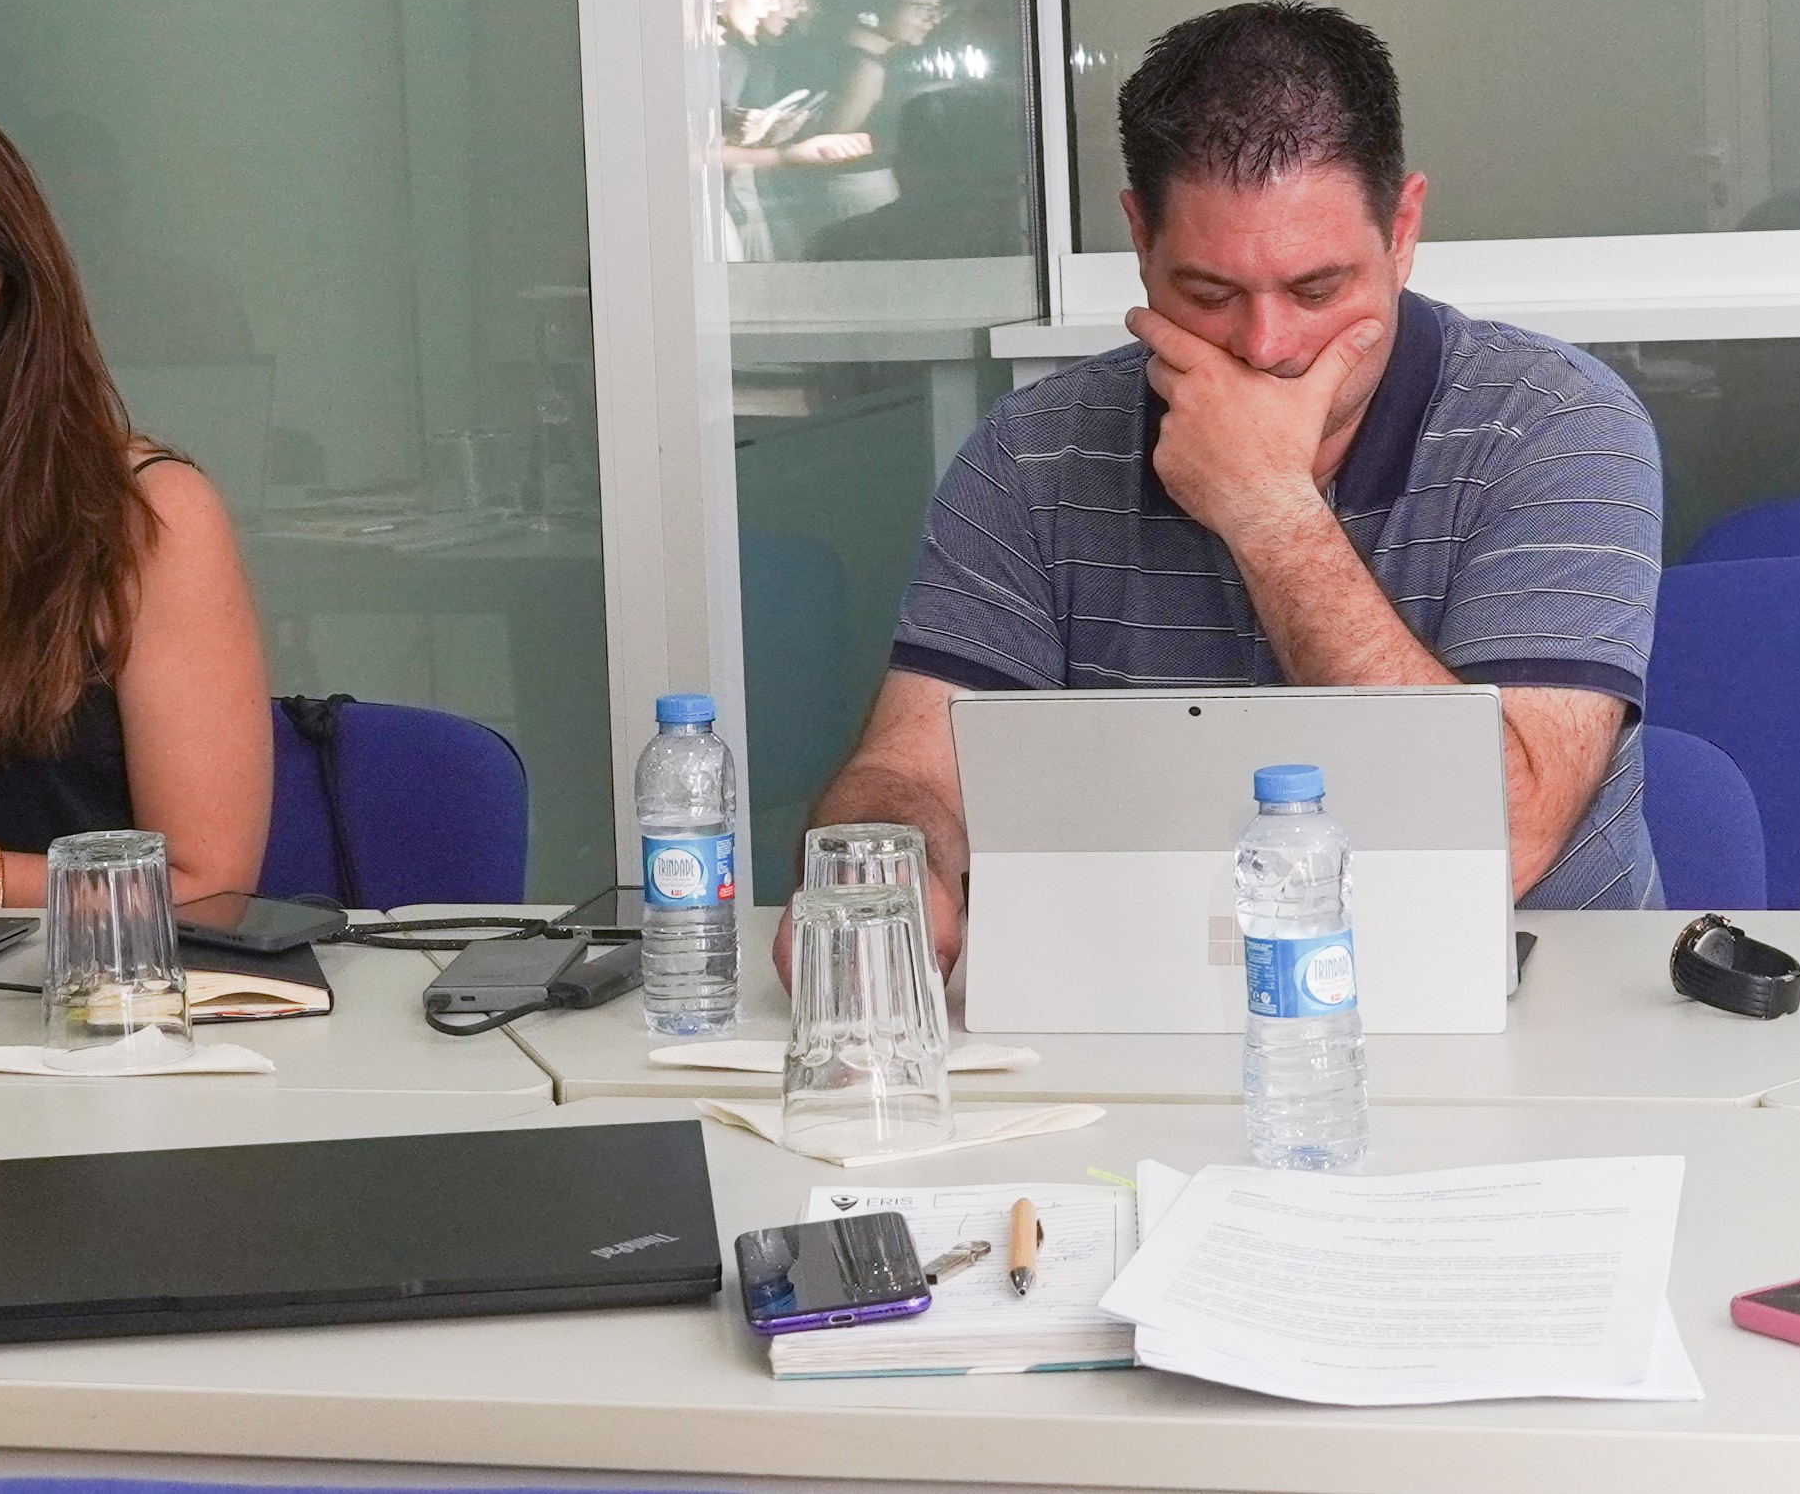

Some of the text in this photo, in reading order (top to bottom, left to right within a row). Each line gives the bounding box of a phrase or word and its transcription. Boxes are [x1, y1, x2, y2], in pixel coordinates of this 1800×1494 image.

[658, 857, 695, 878] TRINDADE
[1314, 952, 1350, 982] TRINDADE
[866, 1196, 914, 1207] ERIS
